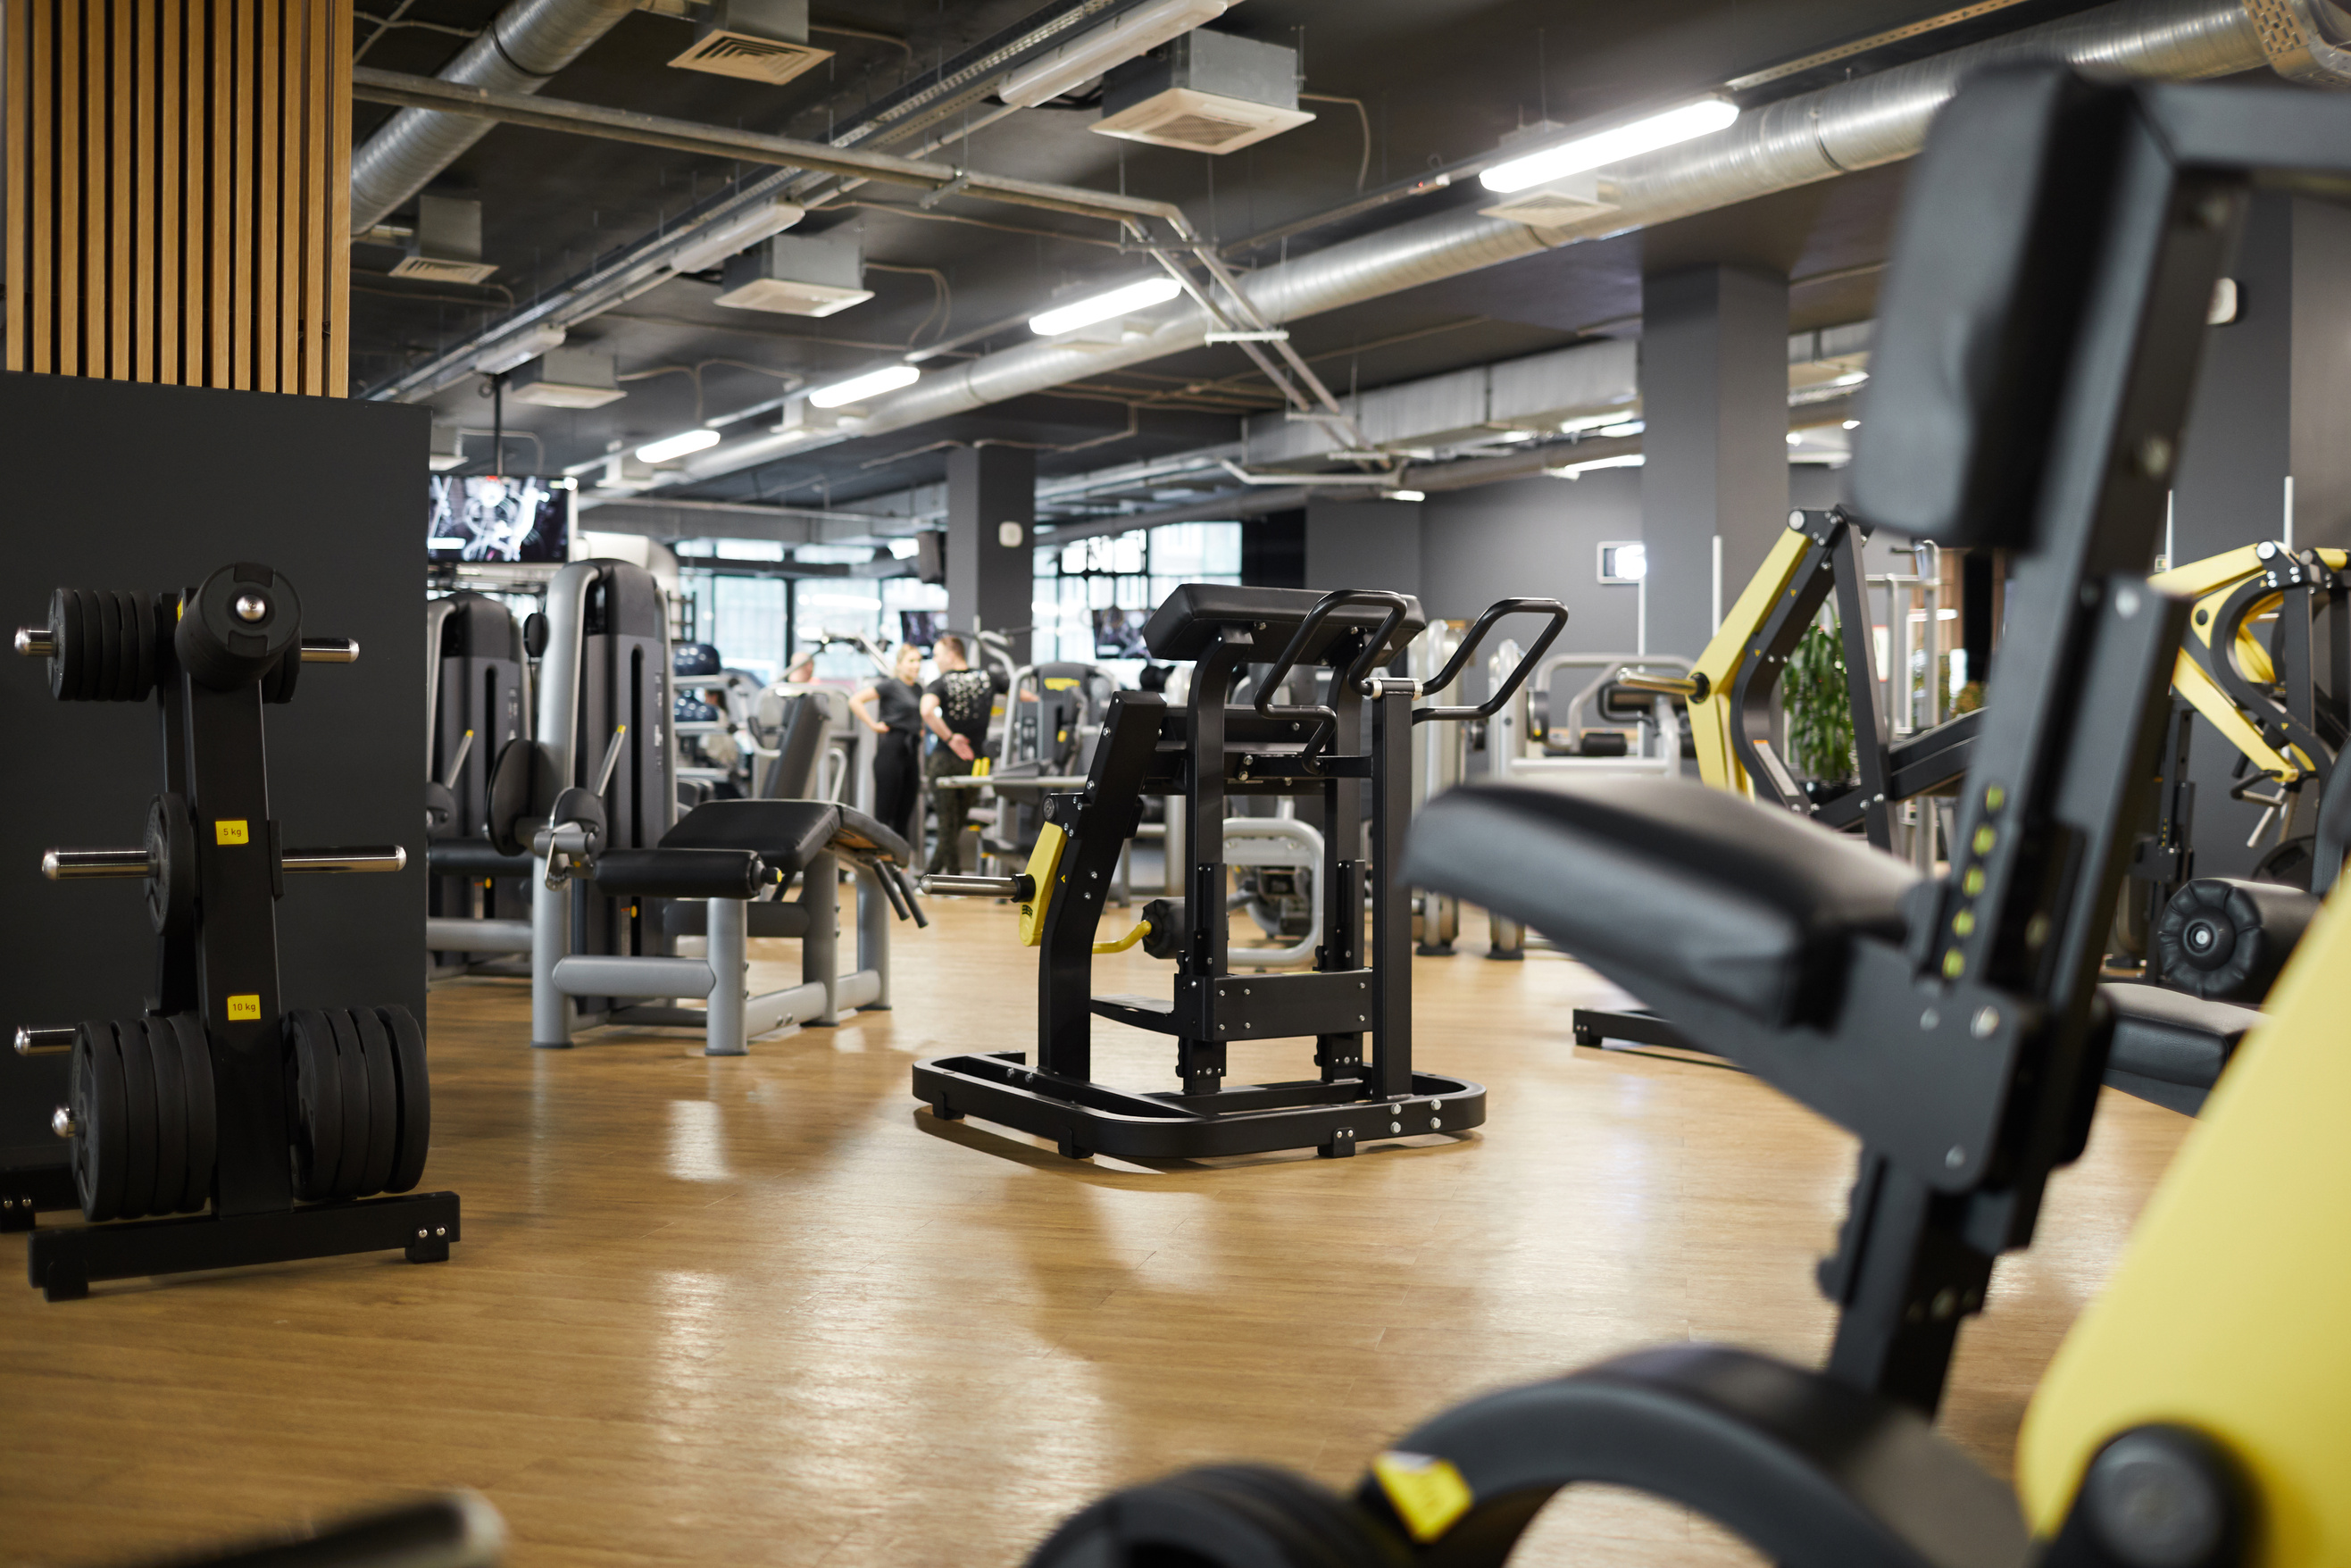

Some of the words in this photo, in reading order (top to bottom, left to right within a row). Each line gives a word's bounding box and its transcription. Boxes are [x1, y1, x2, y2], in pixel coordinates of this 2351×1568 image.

[223, 828, 229, 836] 5
[231, 828, 242, 837] kg
[232, 1003, 243, 1011] 10
[246, 1003, 256, 1013] kg
